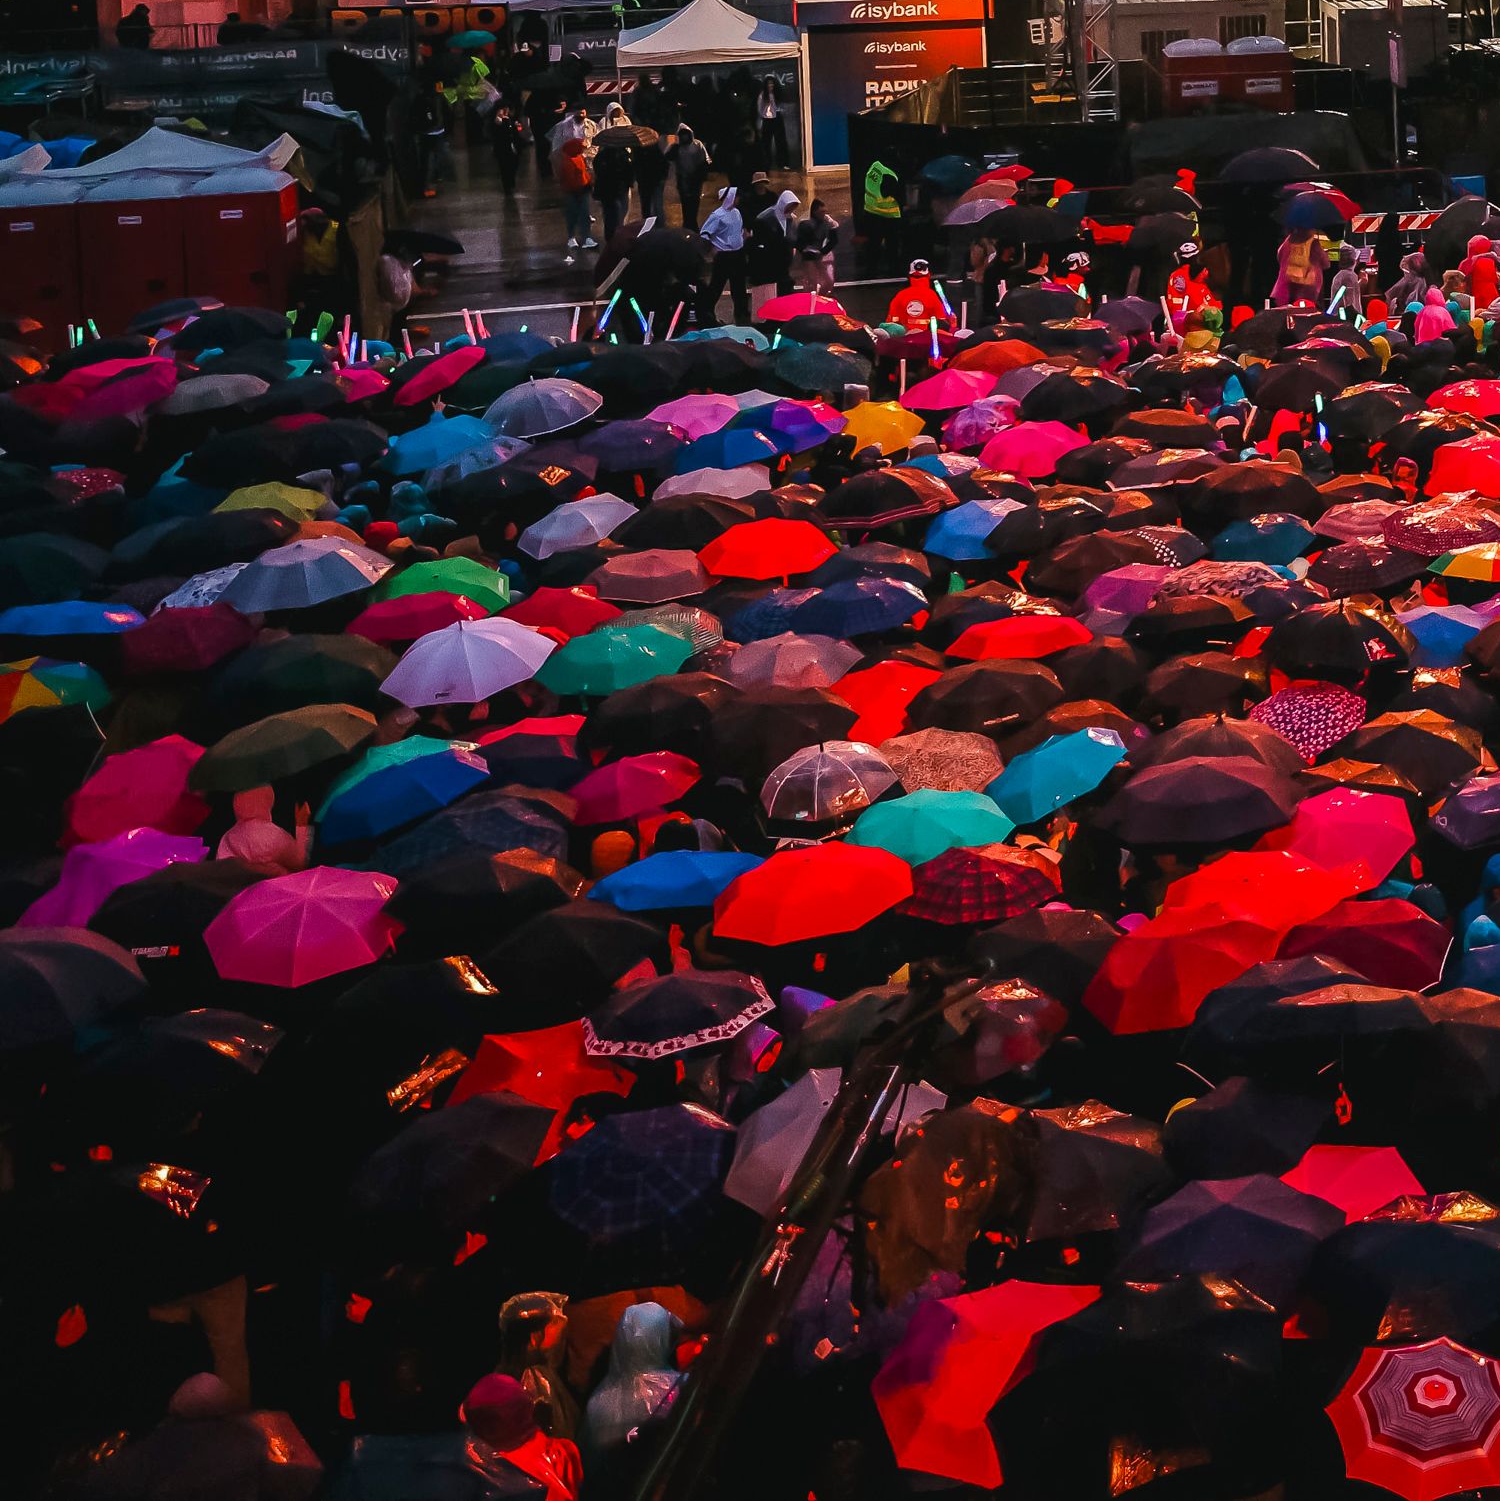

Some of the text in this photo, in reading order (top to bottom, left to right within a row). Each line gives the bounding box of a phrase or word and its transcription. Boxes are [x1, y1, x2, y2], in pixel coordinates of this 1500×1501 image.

[868, 0, 939, 20] isybank
[876, 40, 927, 55] isybank
[865, 79, 928, 95] RADI
